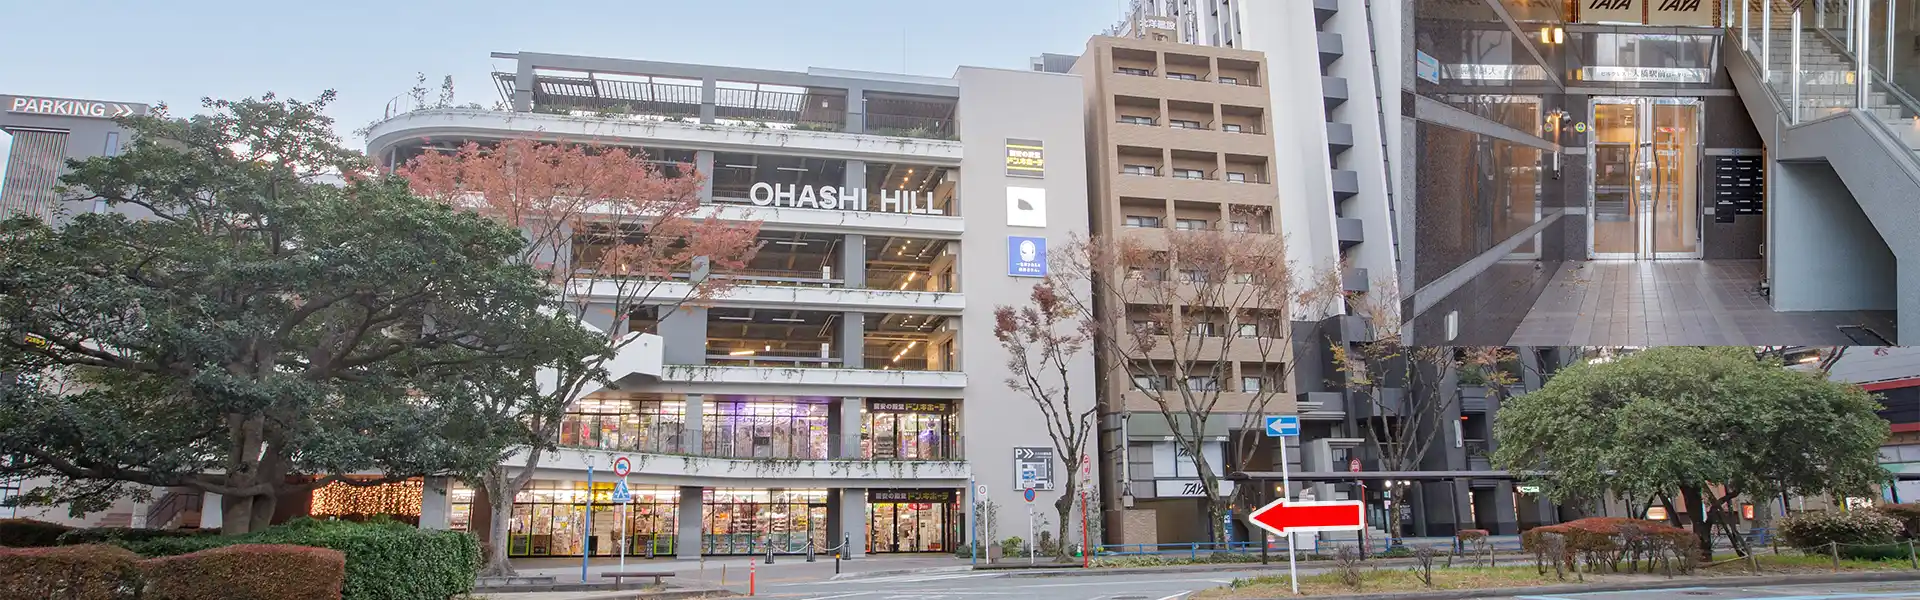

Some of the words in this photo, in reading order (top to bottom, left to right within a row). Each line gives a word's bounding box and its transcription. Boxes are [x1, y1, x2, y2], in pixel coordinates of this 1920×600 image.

[12, 98, 106, 117] PARKING
[749, 182, 867, 210] OHASHI
[880, 189, 943, 215] HILL
[1015, 448, 1023, 459] P
